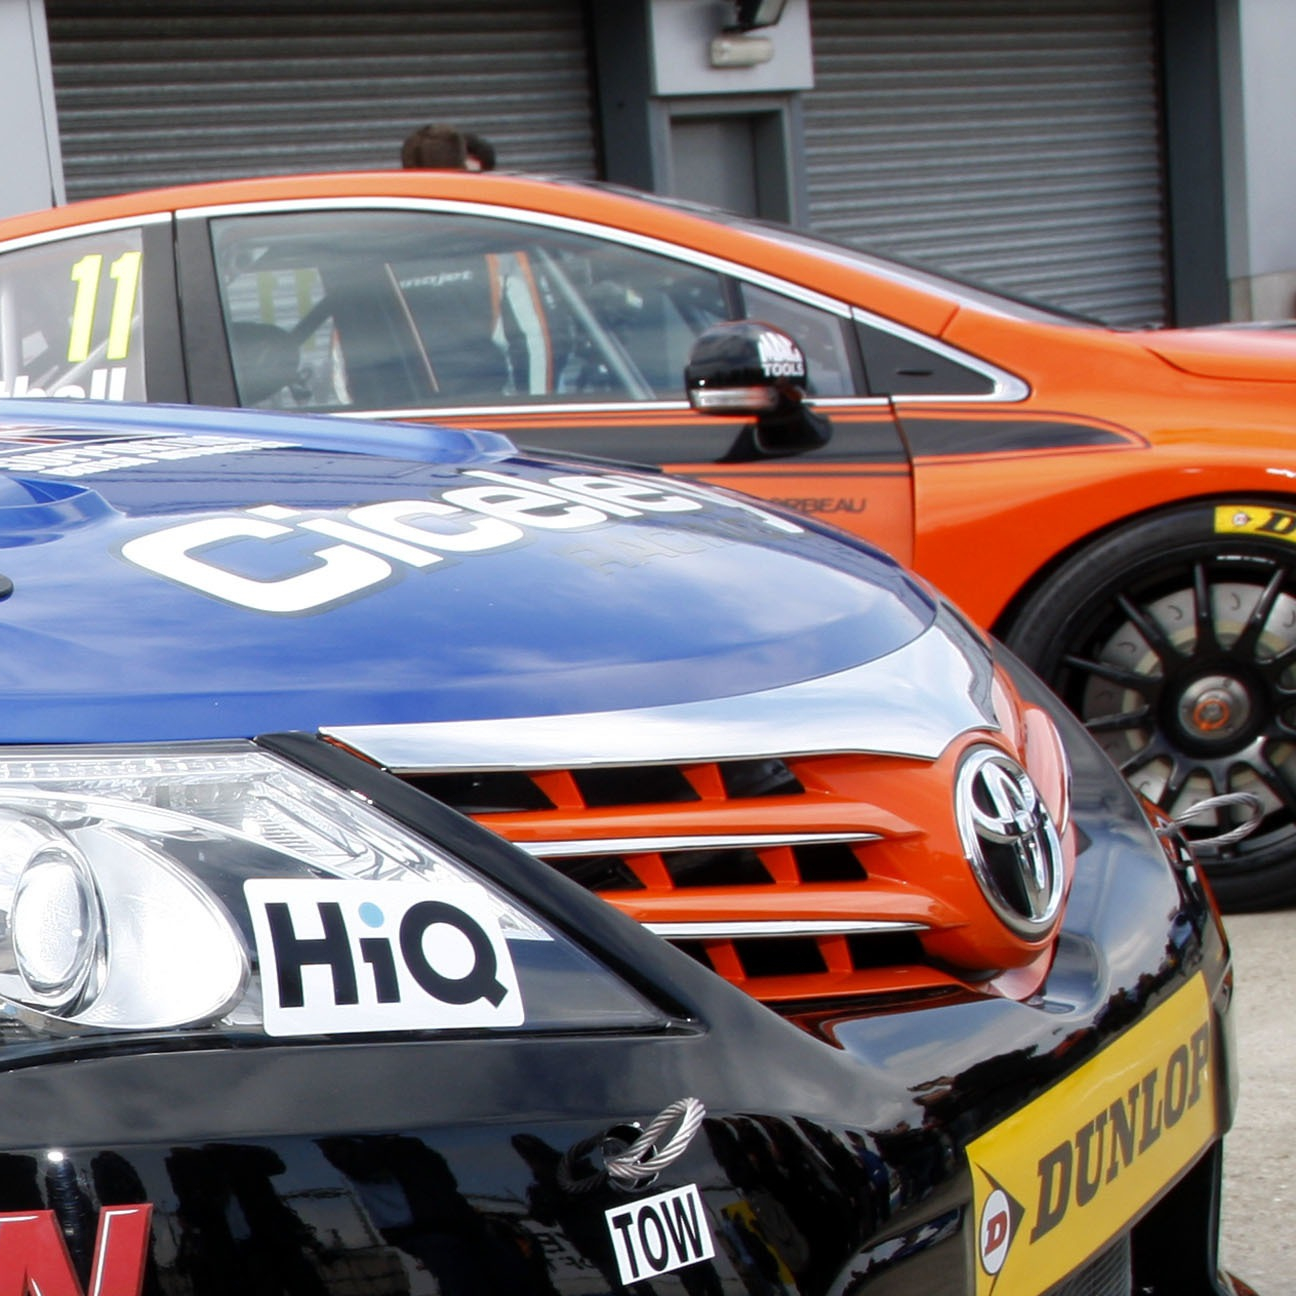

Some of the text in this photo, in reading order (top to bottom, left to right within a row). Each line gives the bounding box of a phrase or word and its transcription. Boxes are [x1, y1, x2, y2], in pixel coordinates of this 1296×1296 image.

[67, 251, 142, 362] 11
[761, 362, 804, 377] TOOLS
[265, 900, 509, 1009] HiQ
[1029, 1020, 1210, 1245] DUNLOP
[612, 1192, 704, 1279] TOW
